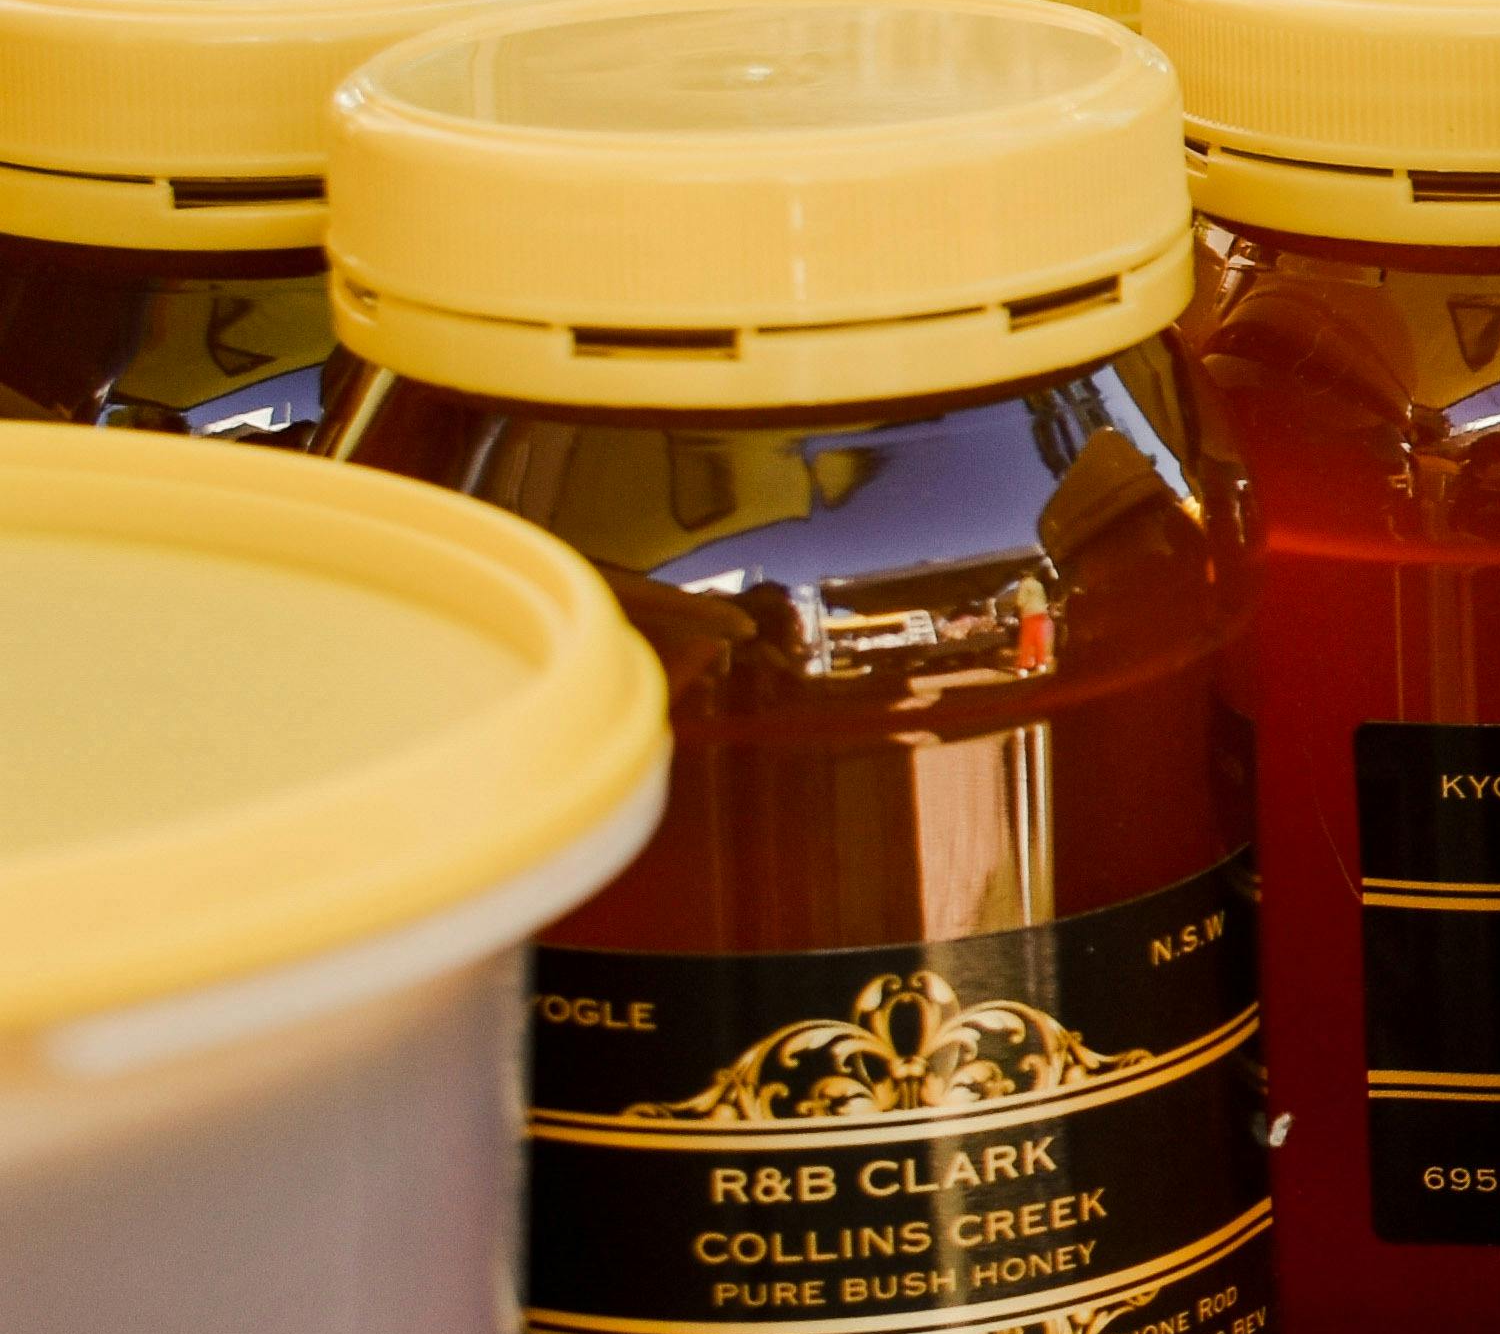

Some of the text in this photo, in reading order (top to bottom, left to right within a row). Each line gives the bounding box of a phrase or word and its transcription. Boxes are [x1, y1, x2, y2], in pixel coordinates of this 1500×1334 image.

[1150, 910, 1225, 965] N.S.W
[709, 1136, 1058, 1206] R&B CLARK
[692, 1188, 1108, 1266] COLLINS CREEK
[712, 1240, 1097, 1308] PURE BUSH HONEY
[1197, 1285, 1238, 1322] ROD
